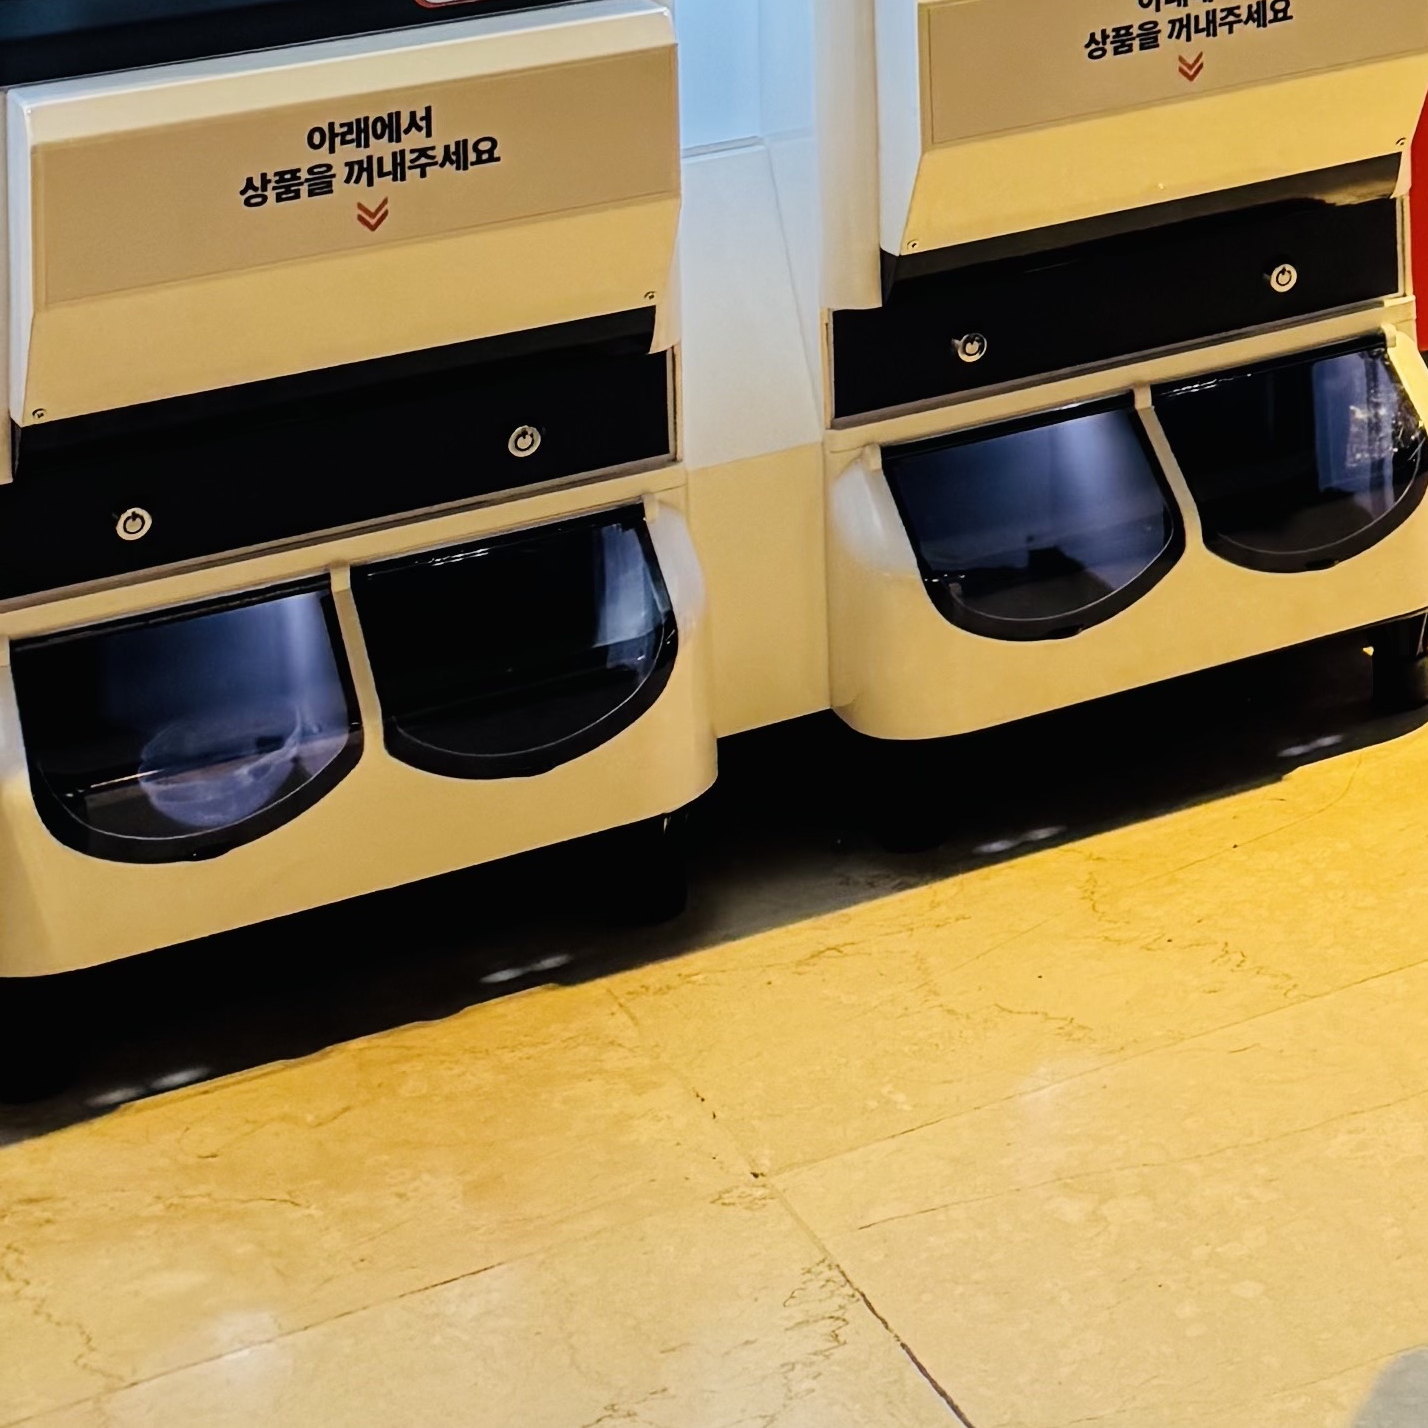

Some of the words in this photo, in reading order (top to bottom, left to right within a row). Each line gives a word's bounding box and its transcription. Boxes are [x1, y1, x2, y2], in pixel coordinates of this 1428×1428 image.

[1084, 19, 1162, 61] 상품을
[305, 105, 434, 155] 아래에서
[239, 162, 336, 209] 상품을
[343, 134, 501, 189] 꺼내주세요
